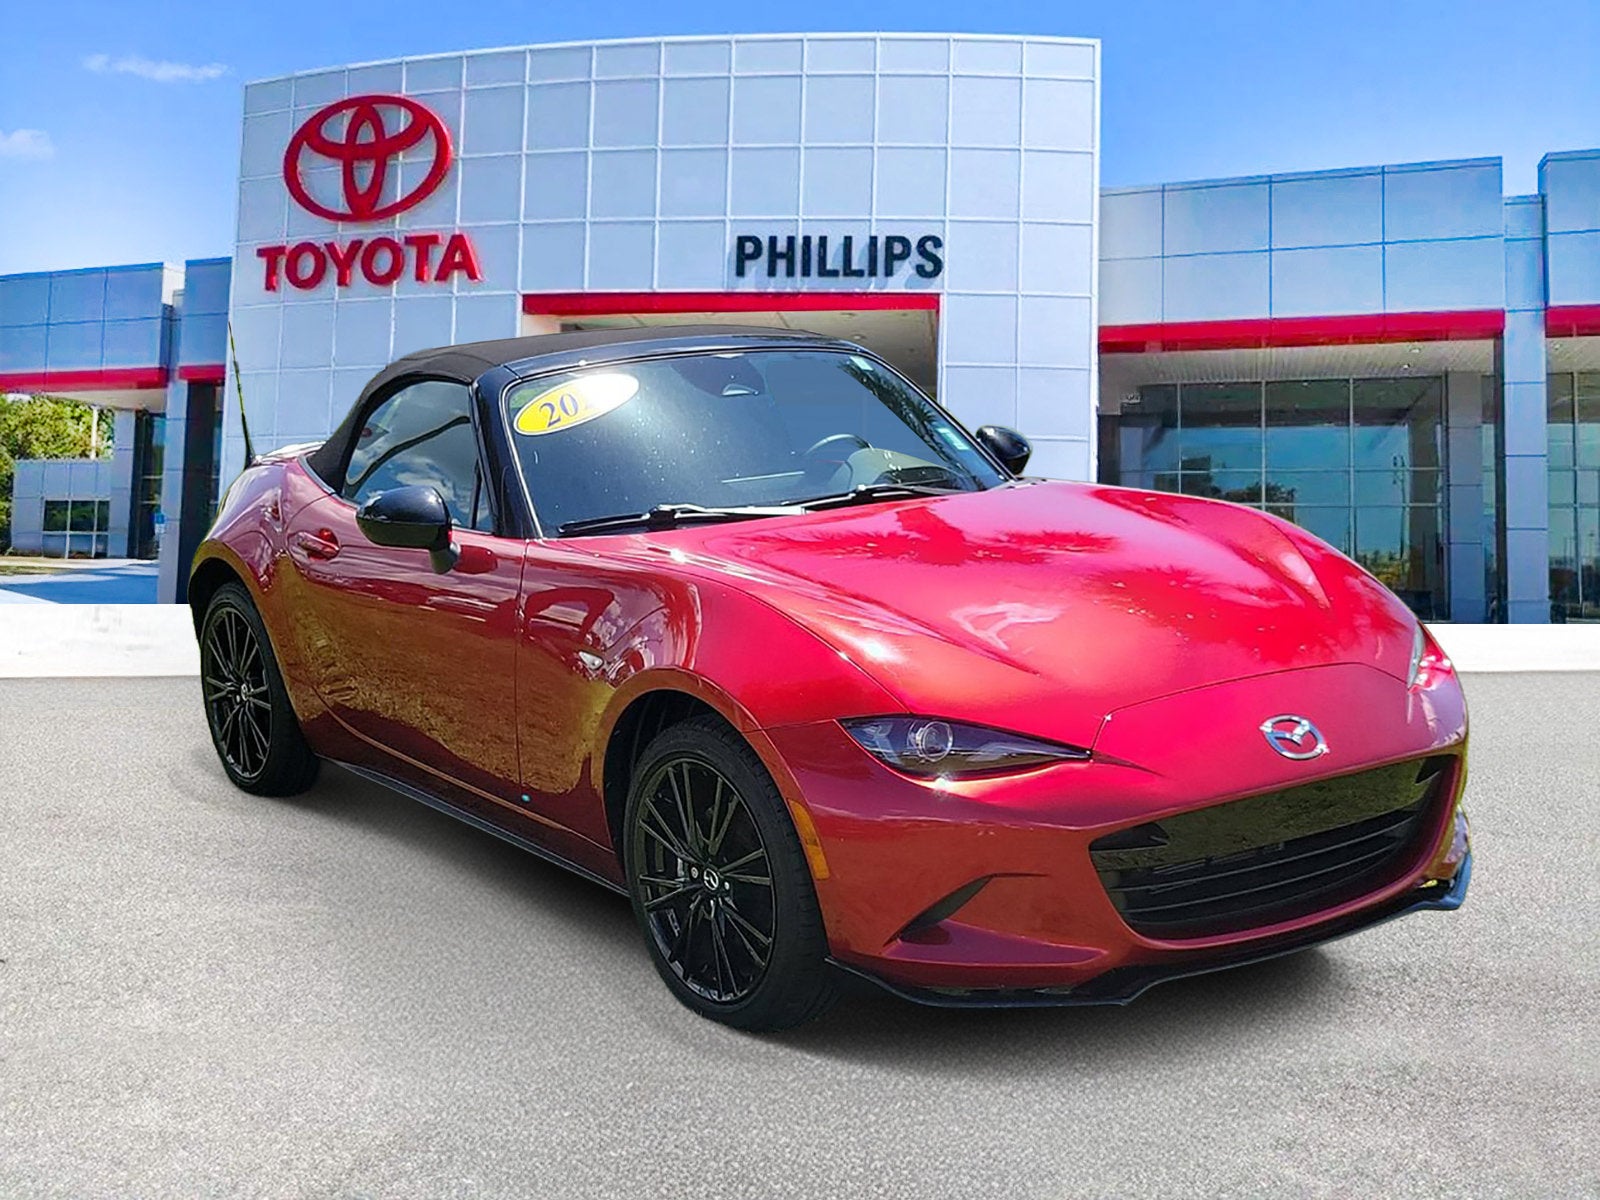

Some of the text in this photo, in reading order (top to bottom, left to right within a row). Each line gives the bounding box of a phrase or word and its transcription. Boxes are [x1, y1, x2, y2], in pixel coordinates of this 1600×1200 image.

[257, 234, 483, 291] TOYOTA
[735, 235, 944, 278] PHILLIPS
[539, 392, 593, 428] 20
